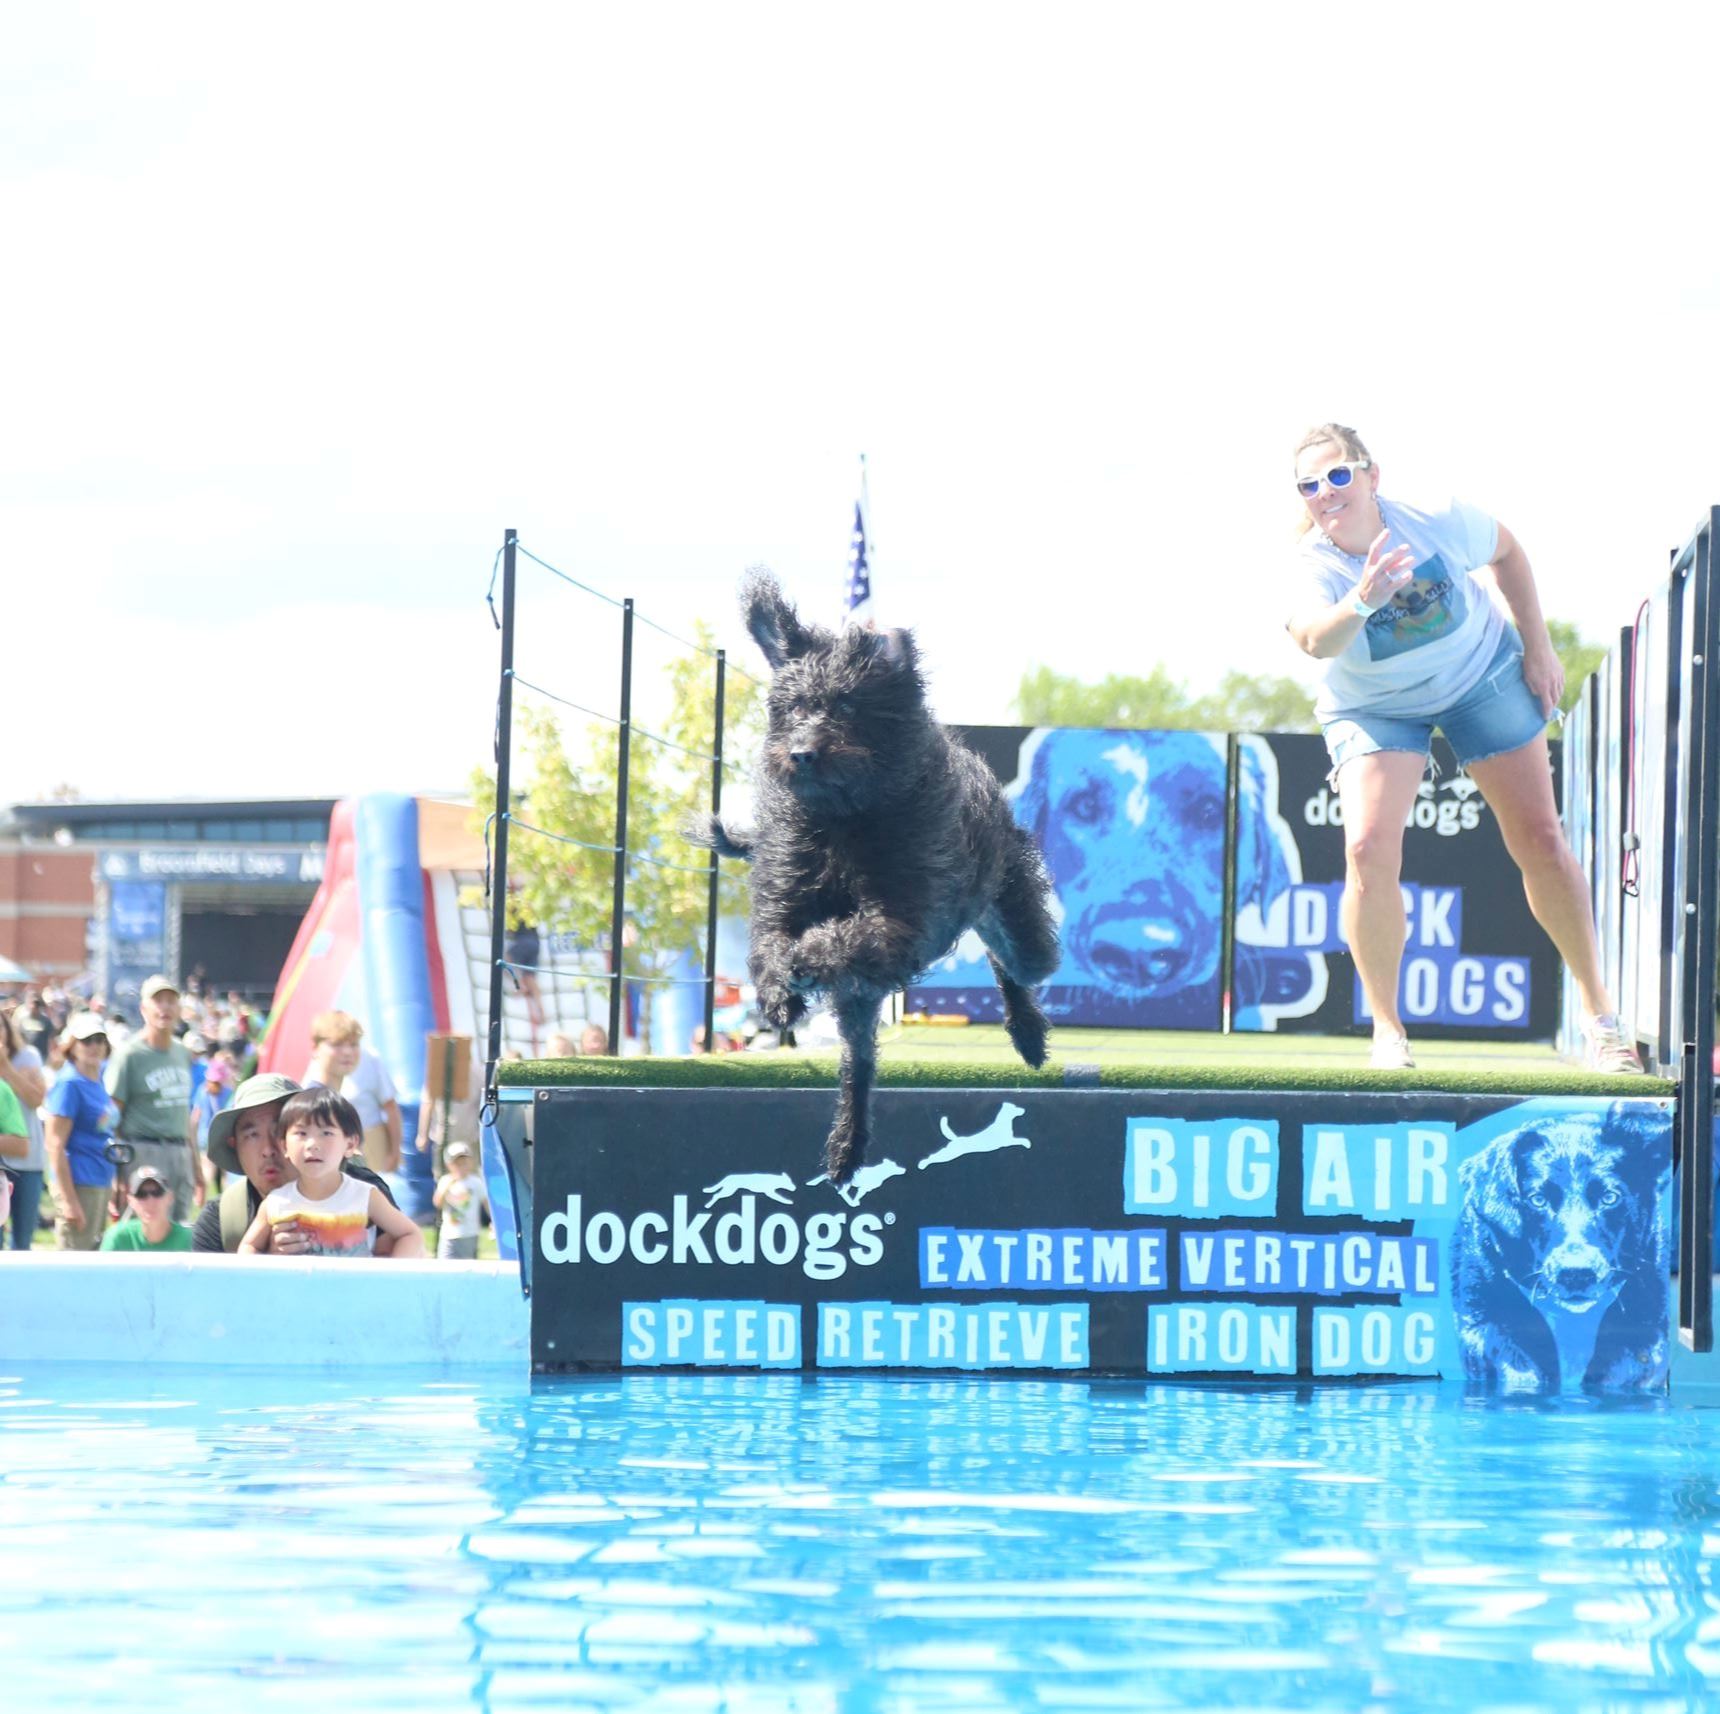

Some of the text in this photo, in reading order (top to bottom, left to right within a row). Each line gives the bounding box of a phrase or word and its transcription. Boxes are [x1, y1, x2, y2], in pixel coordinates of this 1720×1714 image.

[1361, 957, 1526, 1022] OGS
[1133, 1125, 1449, 1211] BIG AIR
[927, 1233, 1435, 1292] EXTREME VERTICAL
[628, 1306, 1435, 1368] SPEED RETRIEVE IRON DOG
